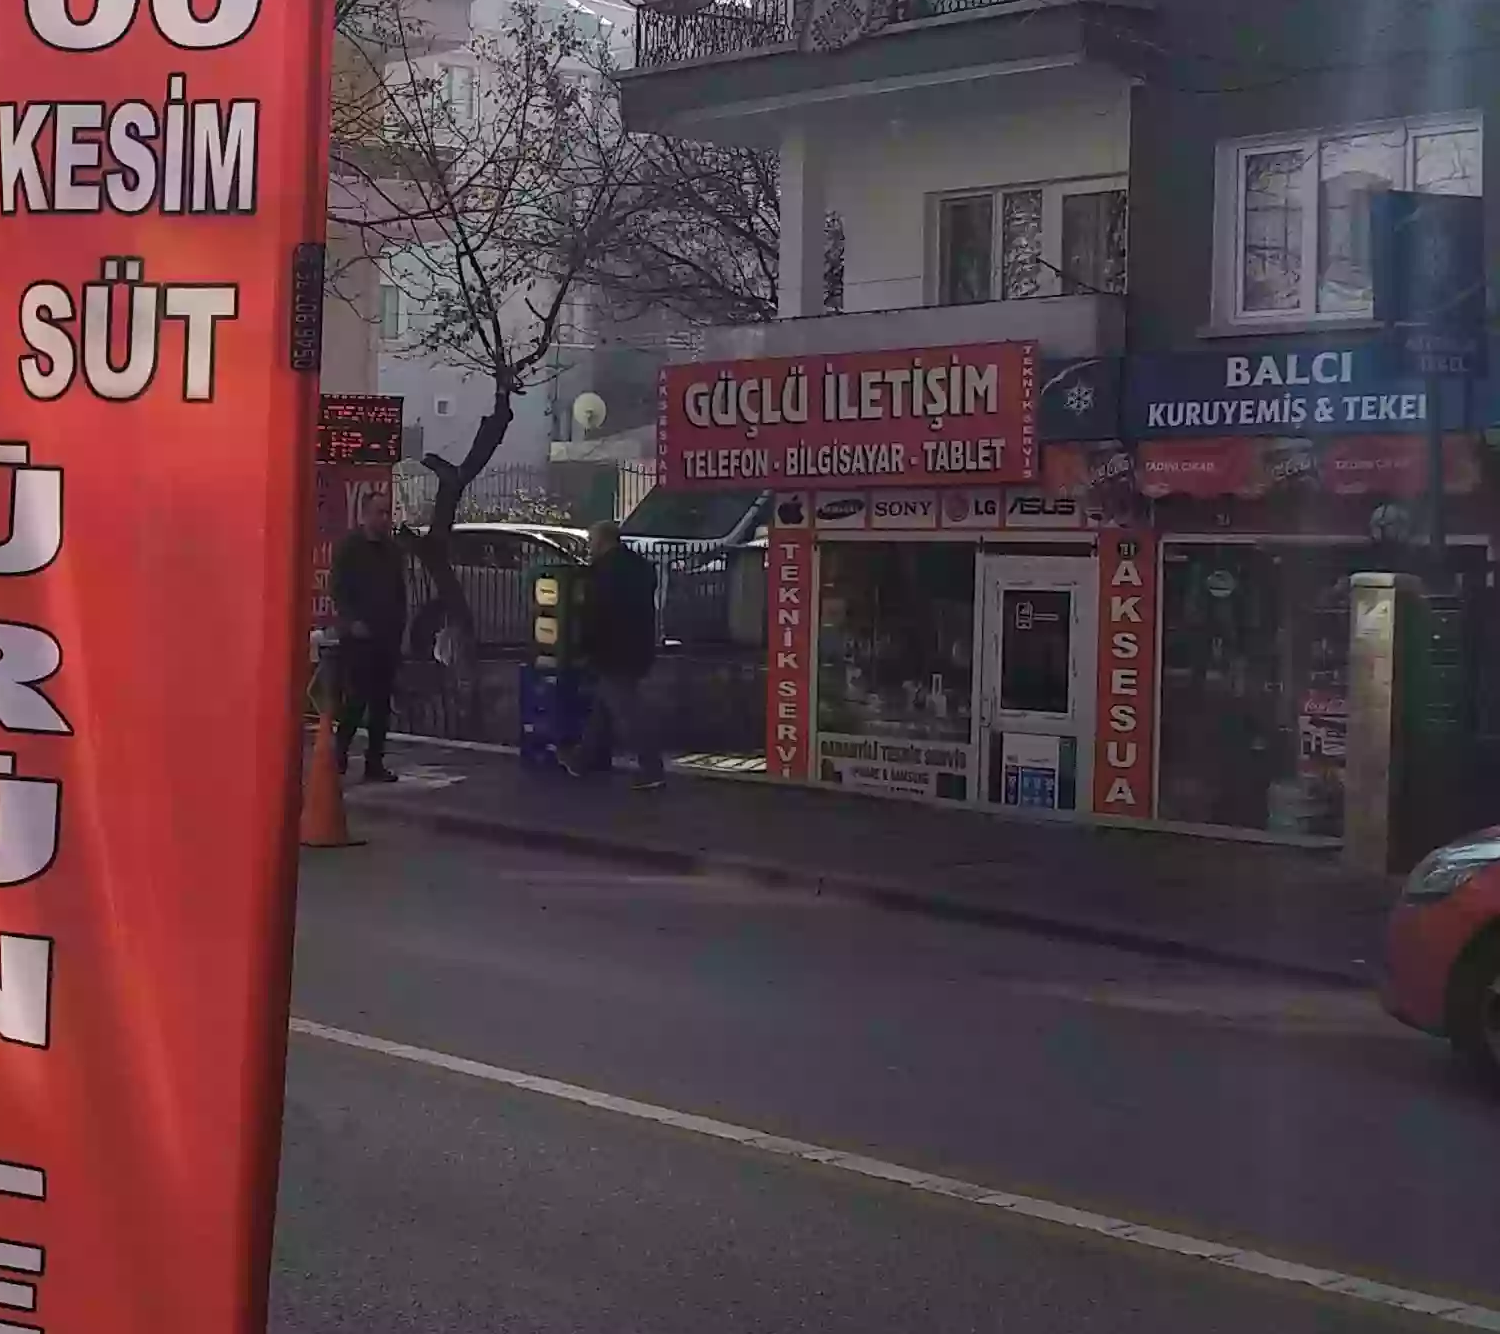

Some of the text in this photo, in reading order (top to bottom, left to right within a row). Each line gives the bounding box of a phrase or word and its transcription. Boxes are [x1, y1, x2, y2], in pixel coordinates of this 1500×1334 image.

[18, 256, 238, 402] SÜT
[1225, 352, 1353, 388] BALCI
[684, 352, 999, 438] GÜÇLÜ İLETİŞİM
[1147, 393, 1307, 428] KURUYEMİŞ
[1314, 398, 1334, 423] &
[683, 449, 769, 479] TELEFON
[786, 439, 906, 477] BİLGİSAYAR
[923, 438, 1006, 472] TABLET
[875, 501, 932, 517] SONY
[974, 501, 996, 516] LG
[1008, 497, 1076, 516] ASUS
[777, 543, 800, 668] TEKNİK
